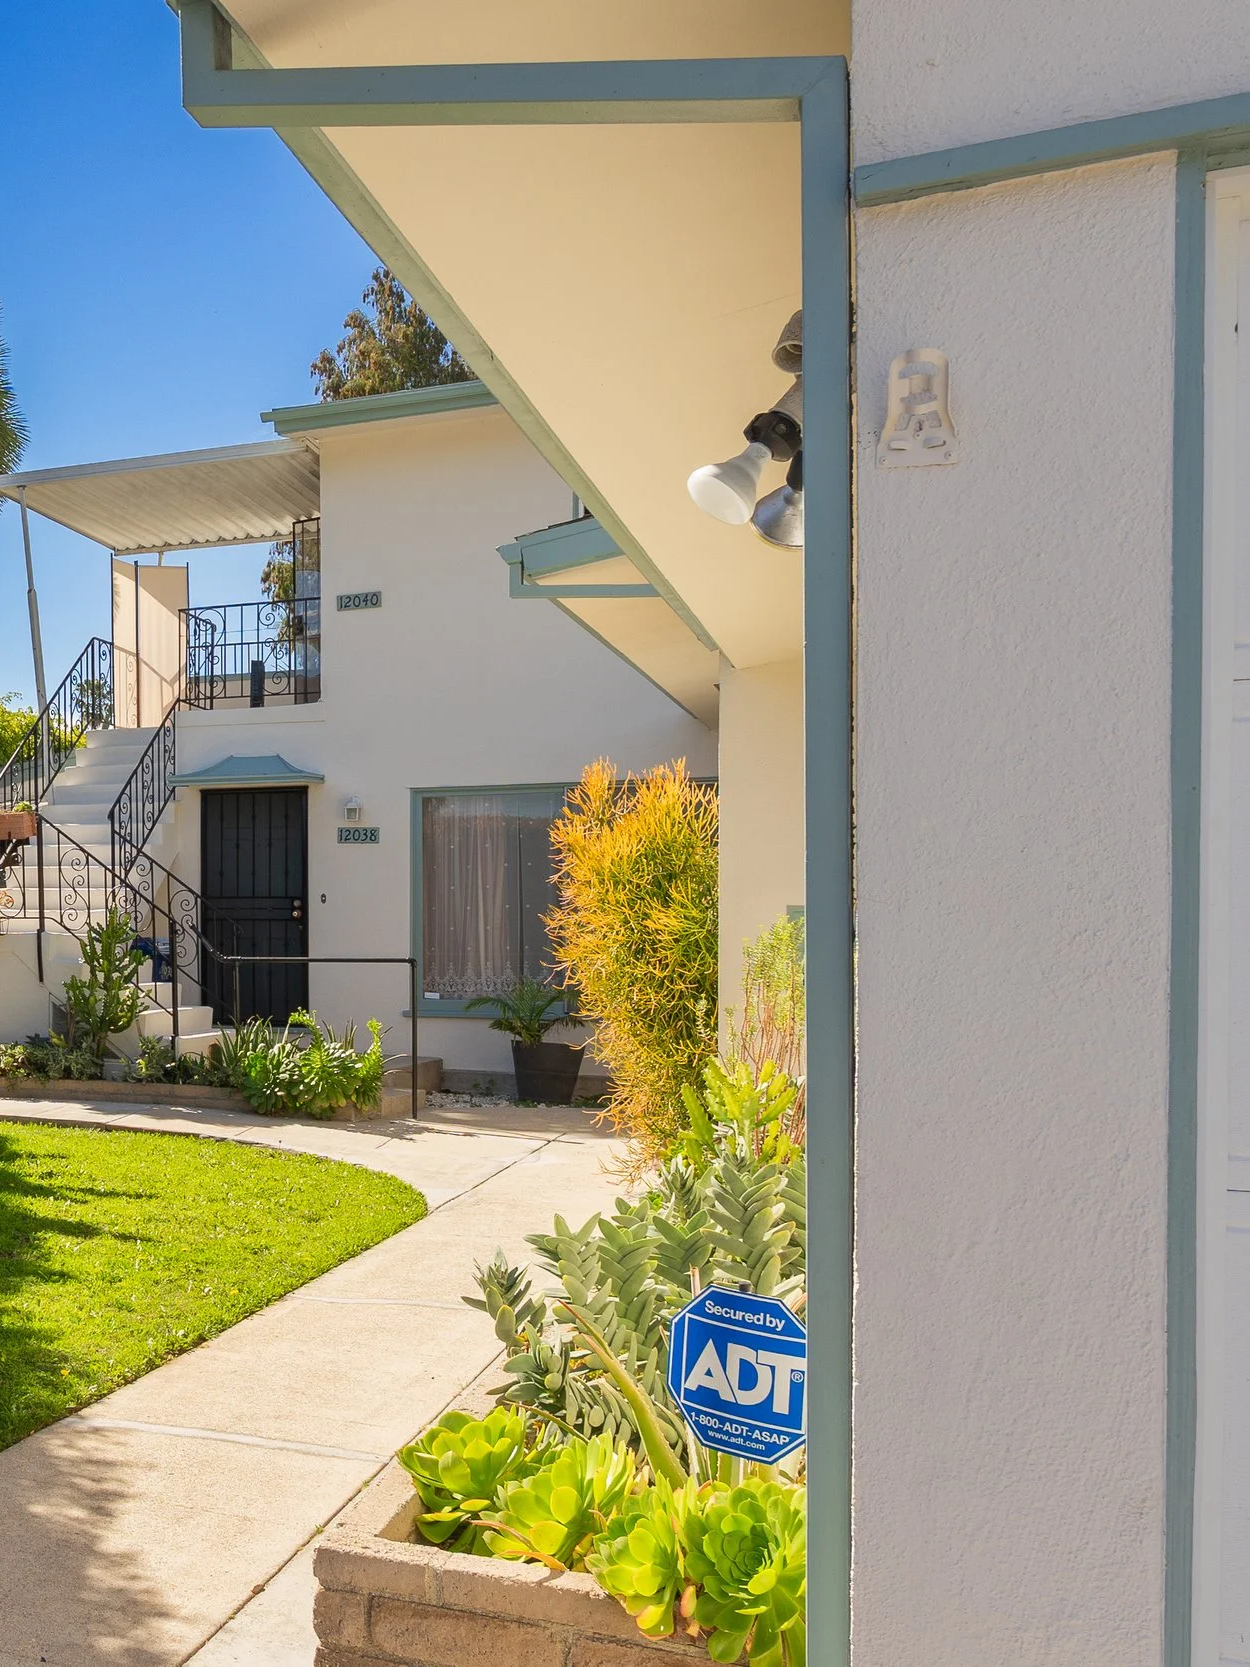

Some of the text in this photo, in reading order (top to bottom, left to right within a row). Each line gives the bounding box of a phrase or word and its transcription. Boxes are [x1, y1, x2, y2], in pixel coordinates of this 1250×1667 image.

[339, 594, 379, 609] 12040
[339, 828, 377, 842] 12038
[705, 1300, 785, 1332] Secured by
[690, 1412, 789, 1446] 1-800-ADT-ASAP
[708, 1429, 766, 1451] www.adt.com
